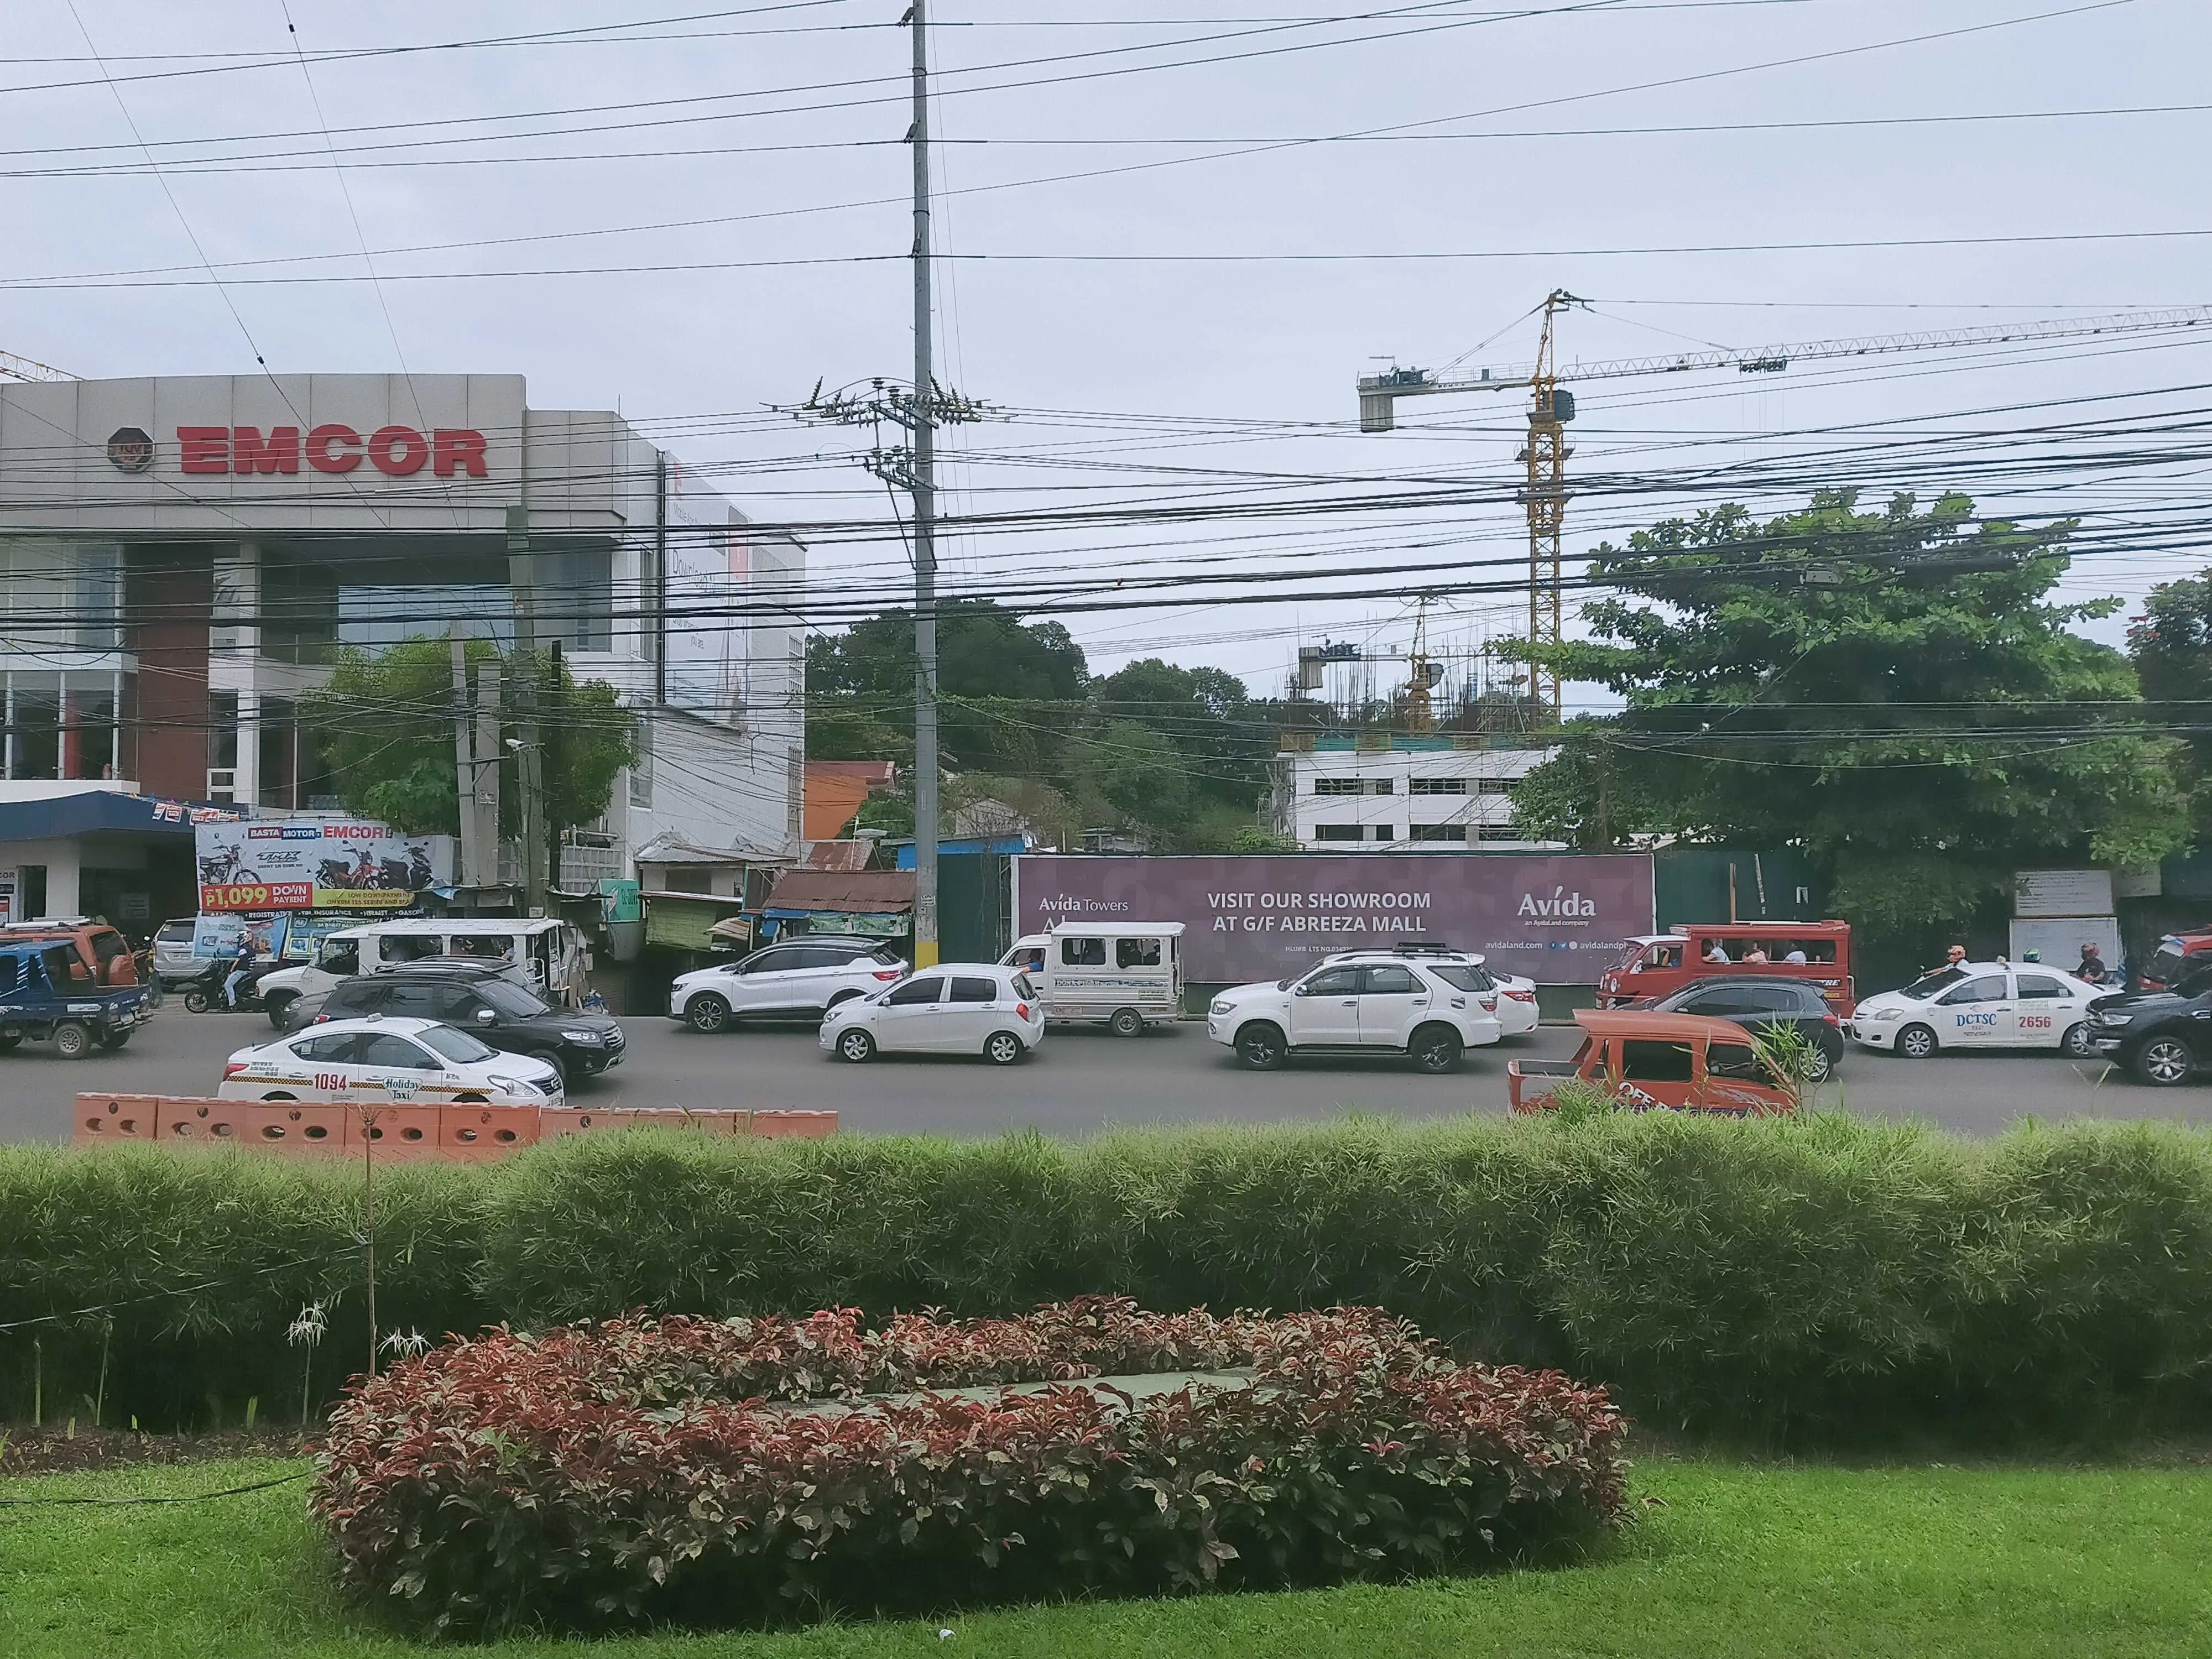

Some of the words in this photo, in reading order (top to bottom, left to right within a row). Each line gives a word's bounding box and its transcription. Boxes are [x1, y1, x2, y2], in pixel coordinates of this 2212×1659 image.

[177, 424, 488, 477] EMCOR
[273, 885, 307, 895] DOWN
[1083, 899, 1129, 911] Towers
[1208, 893, 1255, 908] VISIT
[1260, 893, 1303, 908] OUR
[1308, 893, 1431, 909] SHOWROOM
[1213, 916, 1238, 931] AT
[1243, 916, 1275, 931] G/F
[1280, 916, 1367, 932] ABREEZA
[1373, 916, 1427, 932] MALL
[1485, 941, 1543, 950] avidaland.com
[1956, 1014, 1997, 1027] DCTSC
[2019, 1016, 2052, 1028] 2656
[314, 1073, 347, 1091] 1094
[385, 1078, 420, 1091] Holiday
[393, 1090, 410, 1099] Taxi
